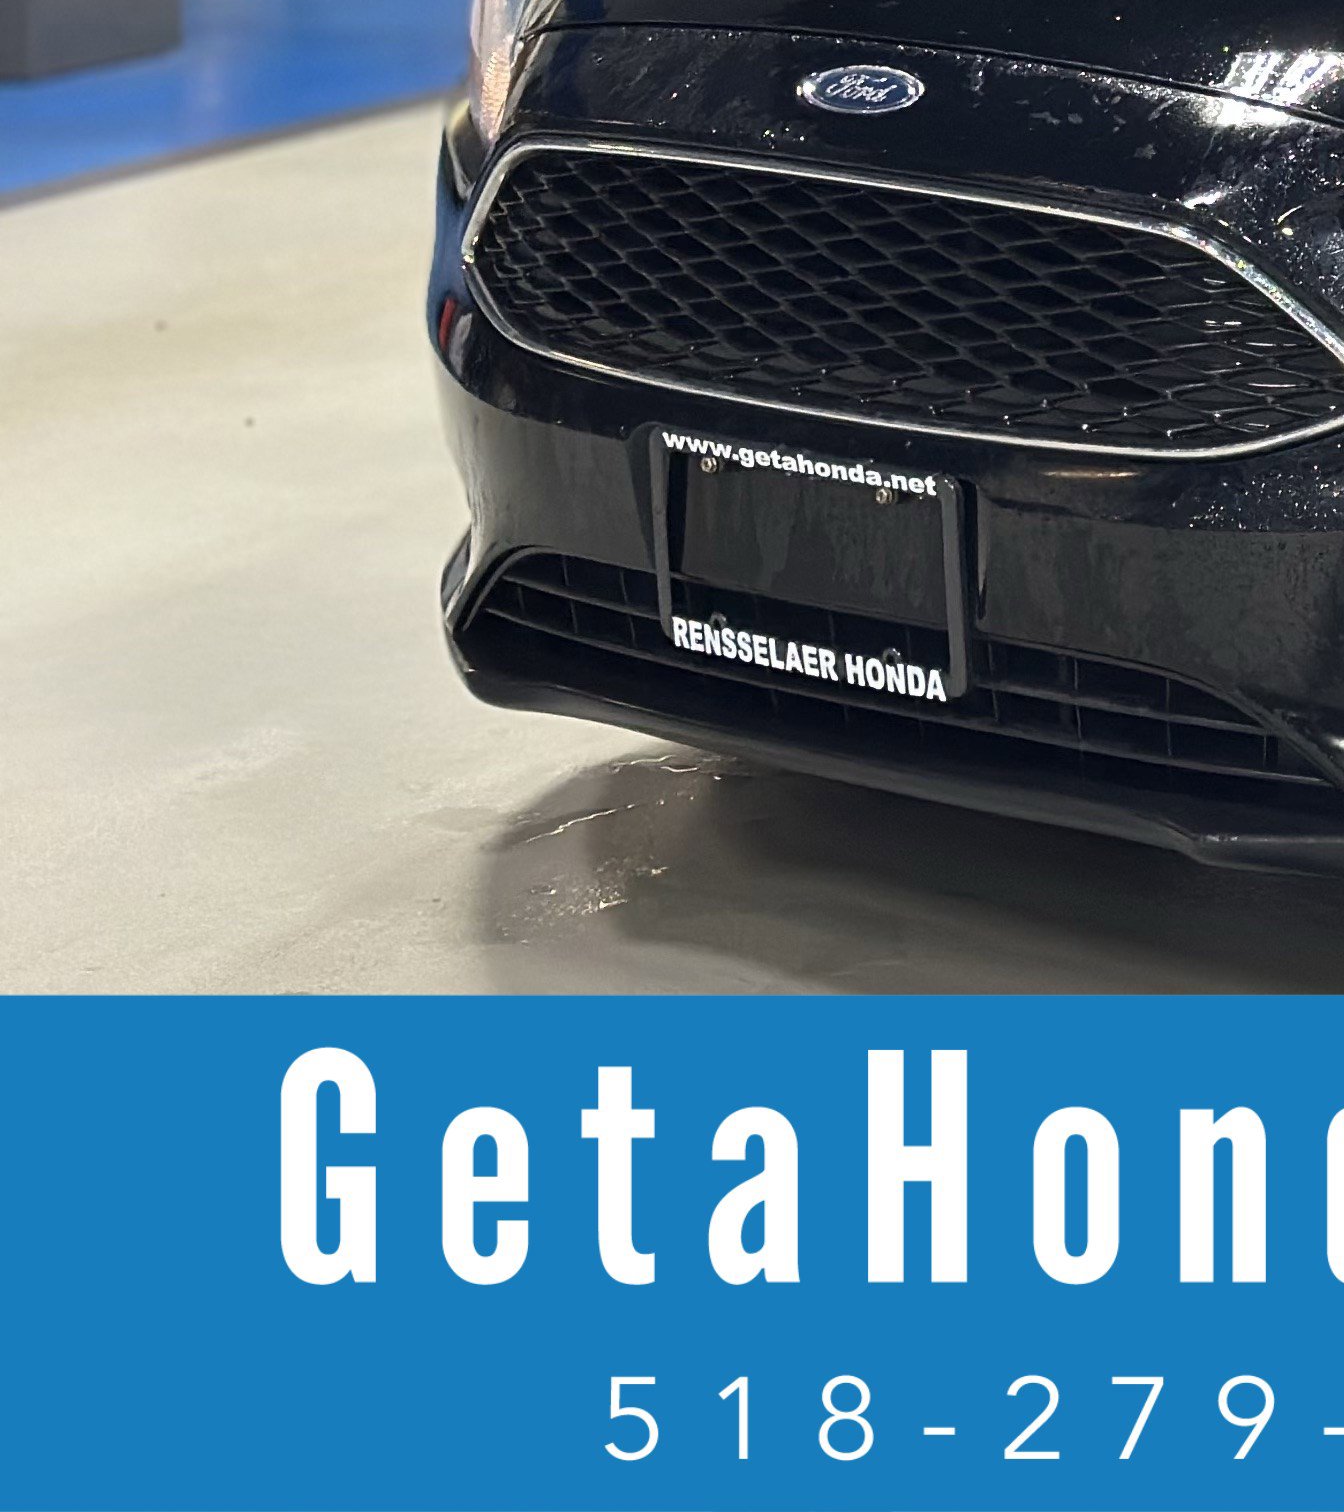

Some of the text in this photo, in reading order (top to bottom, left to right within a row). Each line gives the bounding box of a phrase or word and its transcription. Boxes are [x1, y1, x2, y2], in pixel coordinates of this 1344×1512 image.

[826, 73, 898, 103] Ford
[662, 431, 938, 496] www.getahonda.net
[672, 616, 947, 702] RENSSELAER HONDA
